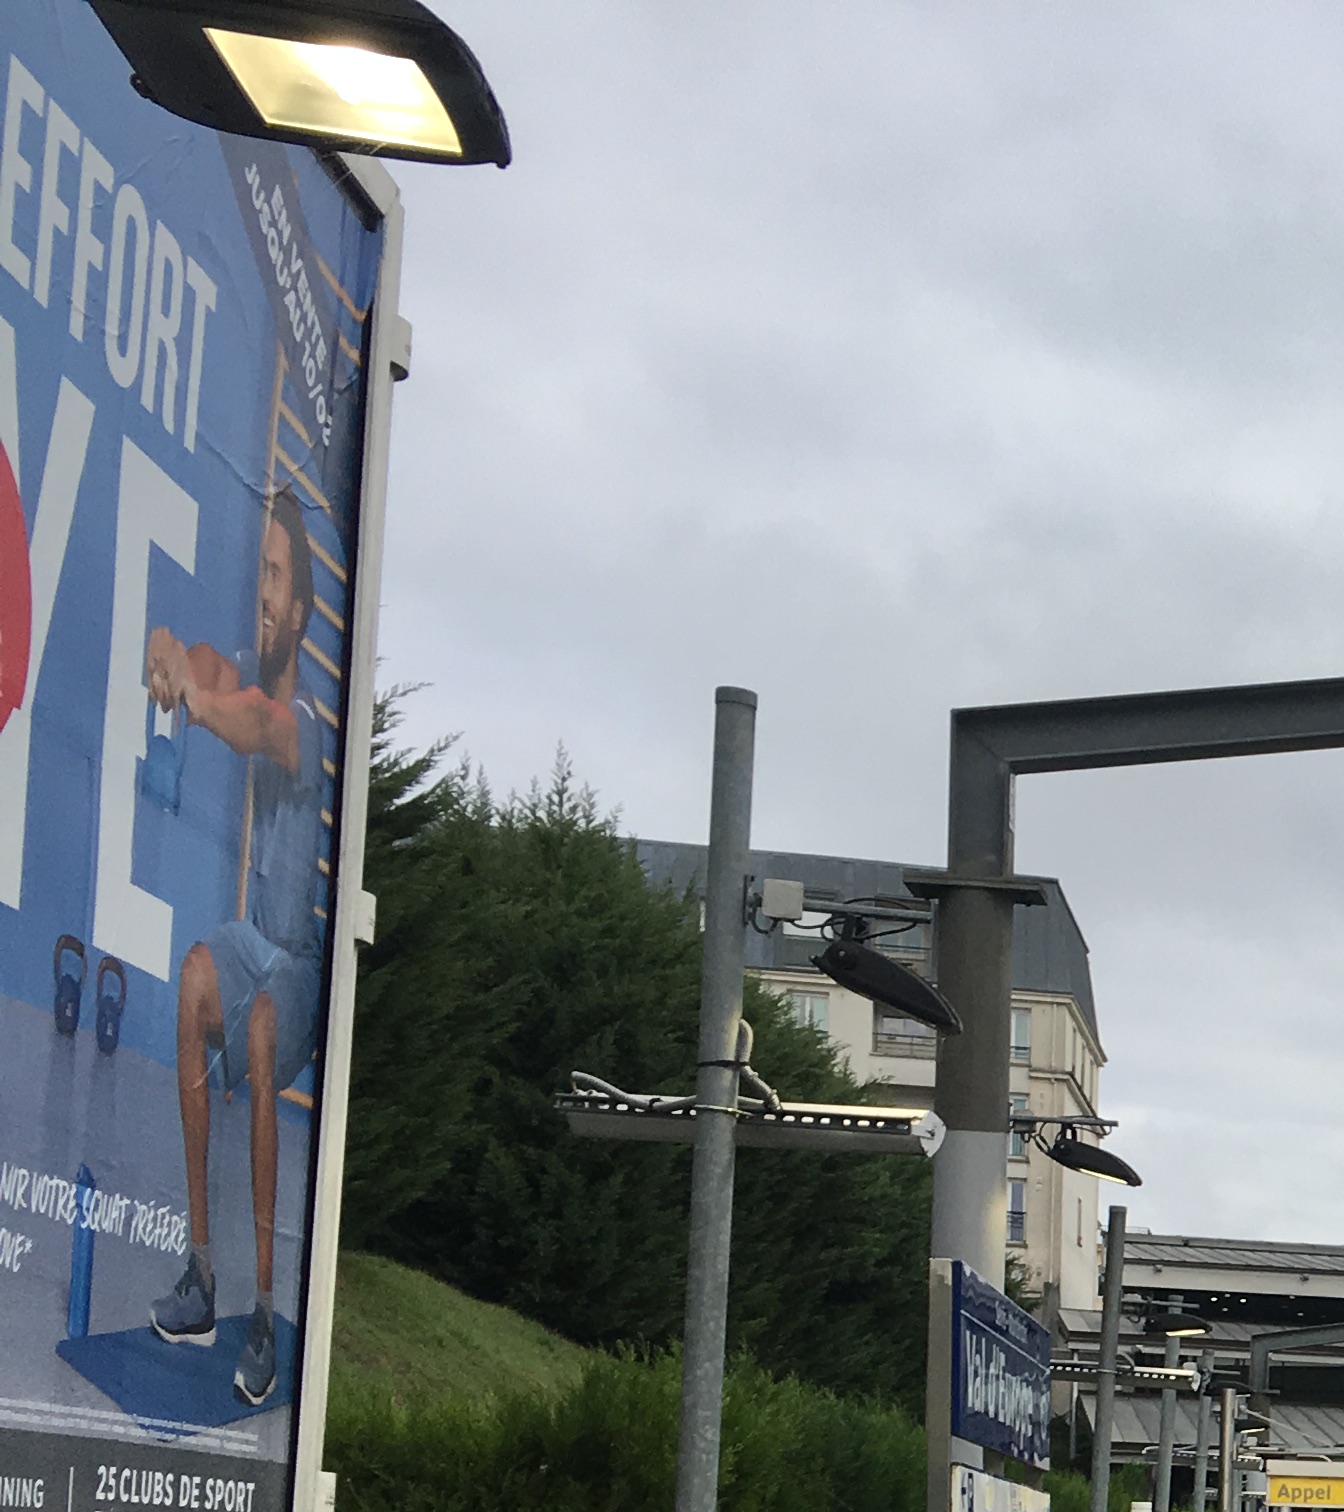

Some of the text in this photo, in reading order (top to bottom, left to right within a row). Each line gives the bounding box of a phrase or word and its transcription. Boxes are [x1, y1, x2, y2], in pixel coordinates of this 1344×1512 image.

[0, 53, 218, 454] EFFORT
[270, 184, 328, 370] EN VENTE
[31, 1171, 78, 1225] VOTRE
[80, 1187, 131, 1237] SQUAT
[129, 1200, 188, 1256] PRÉFÉRÉ
[965, 1330, 986, 1414] Val
[95, 1464, 117, 1501] 25
[119, 1468, 175, 1507] CLUBS
[178, 1474, 201, 1509] DE
[1277, 1483, 1331, 1502] Appel
